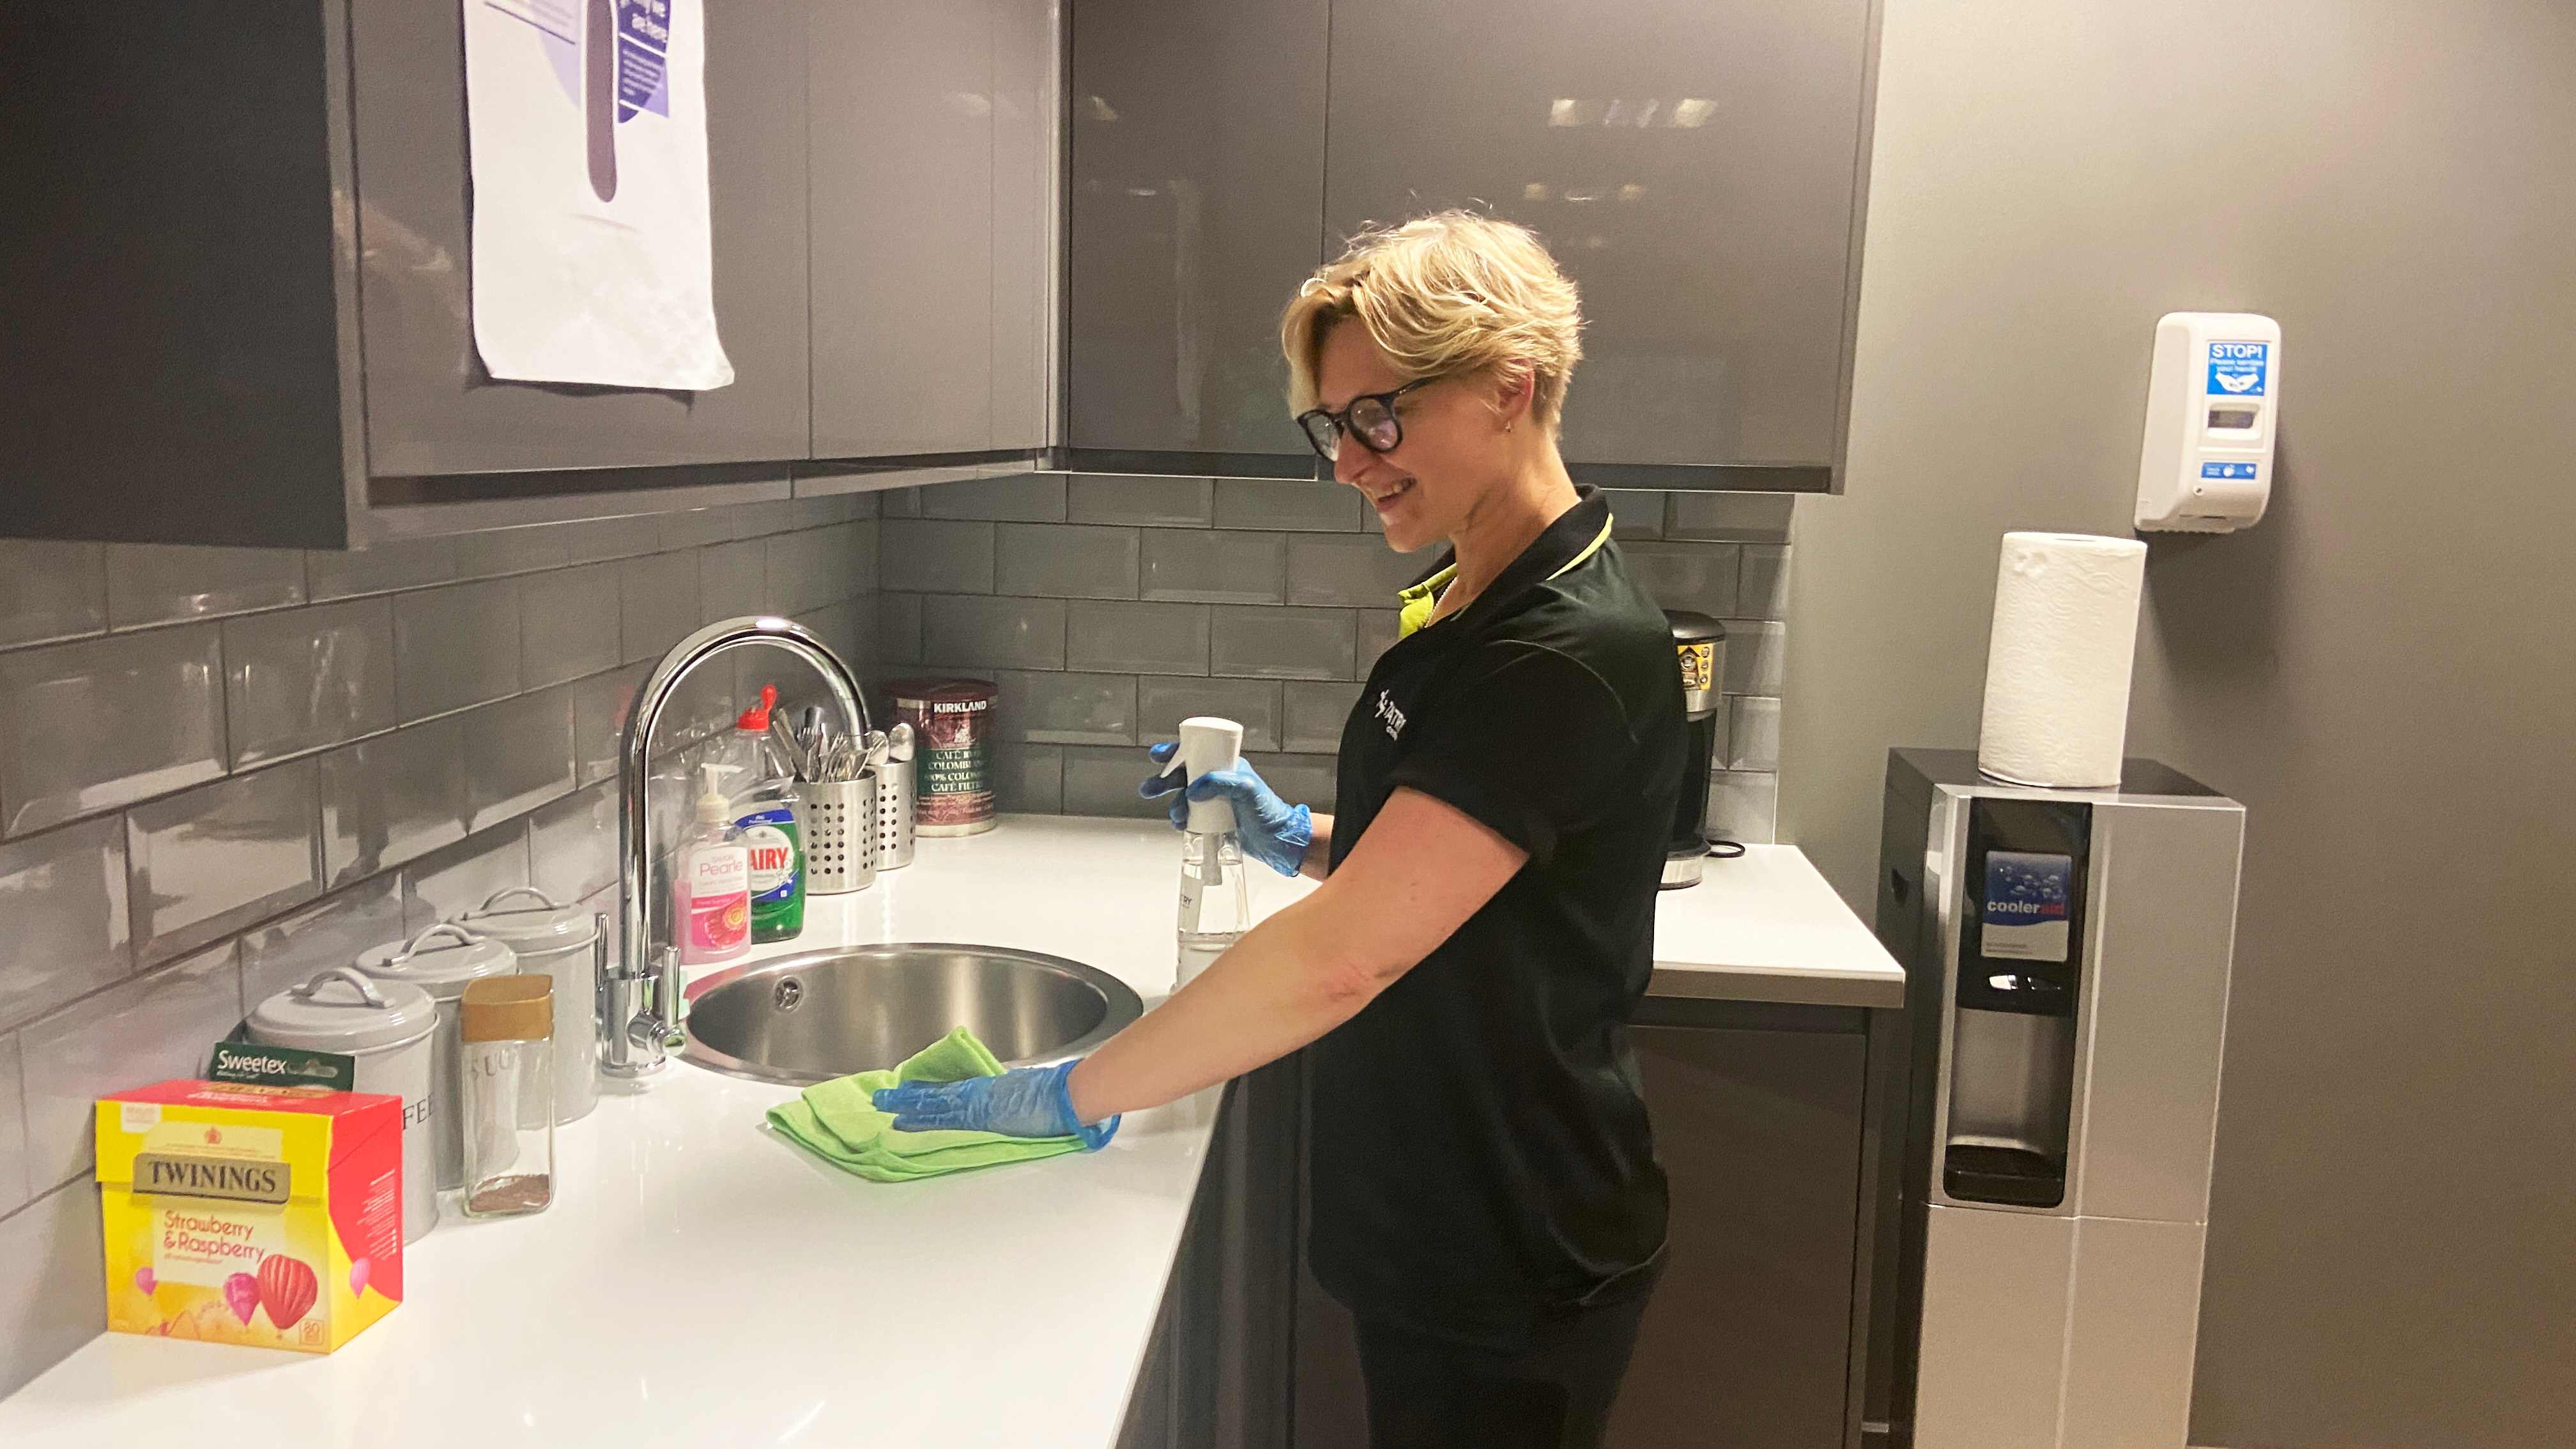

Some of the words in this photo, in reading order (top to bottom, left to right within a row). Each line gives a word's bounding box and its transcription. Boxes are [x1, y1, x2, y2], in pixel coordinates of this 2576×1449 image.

[2212, 344, 2263, 358] STOP!
[933, 700, 987, 713] KIRKLAND
[700, 860, 743, 877] Pearle
[749, 847, 789, 870] AIRY
[217, 1050, 286, 1075] Sweetex
[148, 1160, 276, 1193] TWININGS
[164, 1209, 254, 1241] Strawberry
[164, 1230, 176, 1248] &
[178, 1232, 264, 1263] Raspberry
